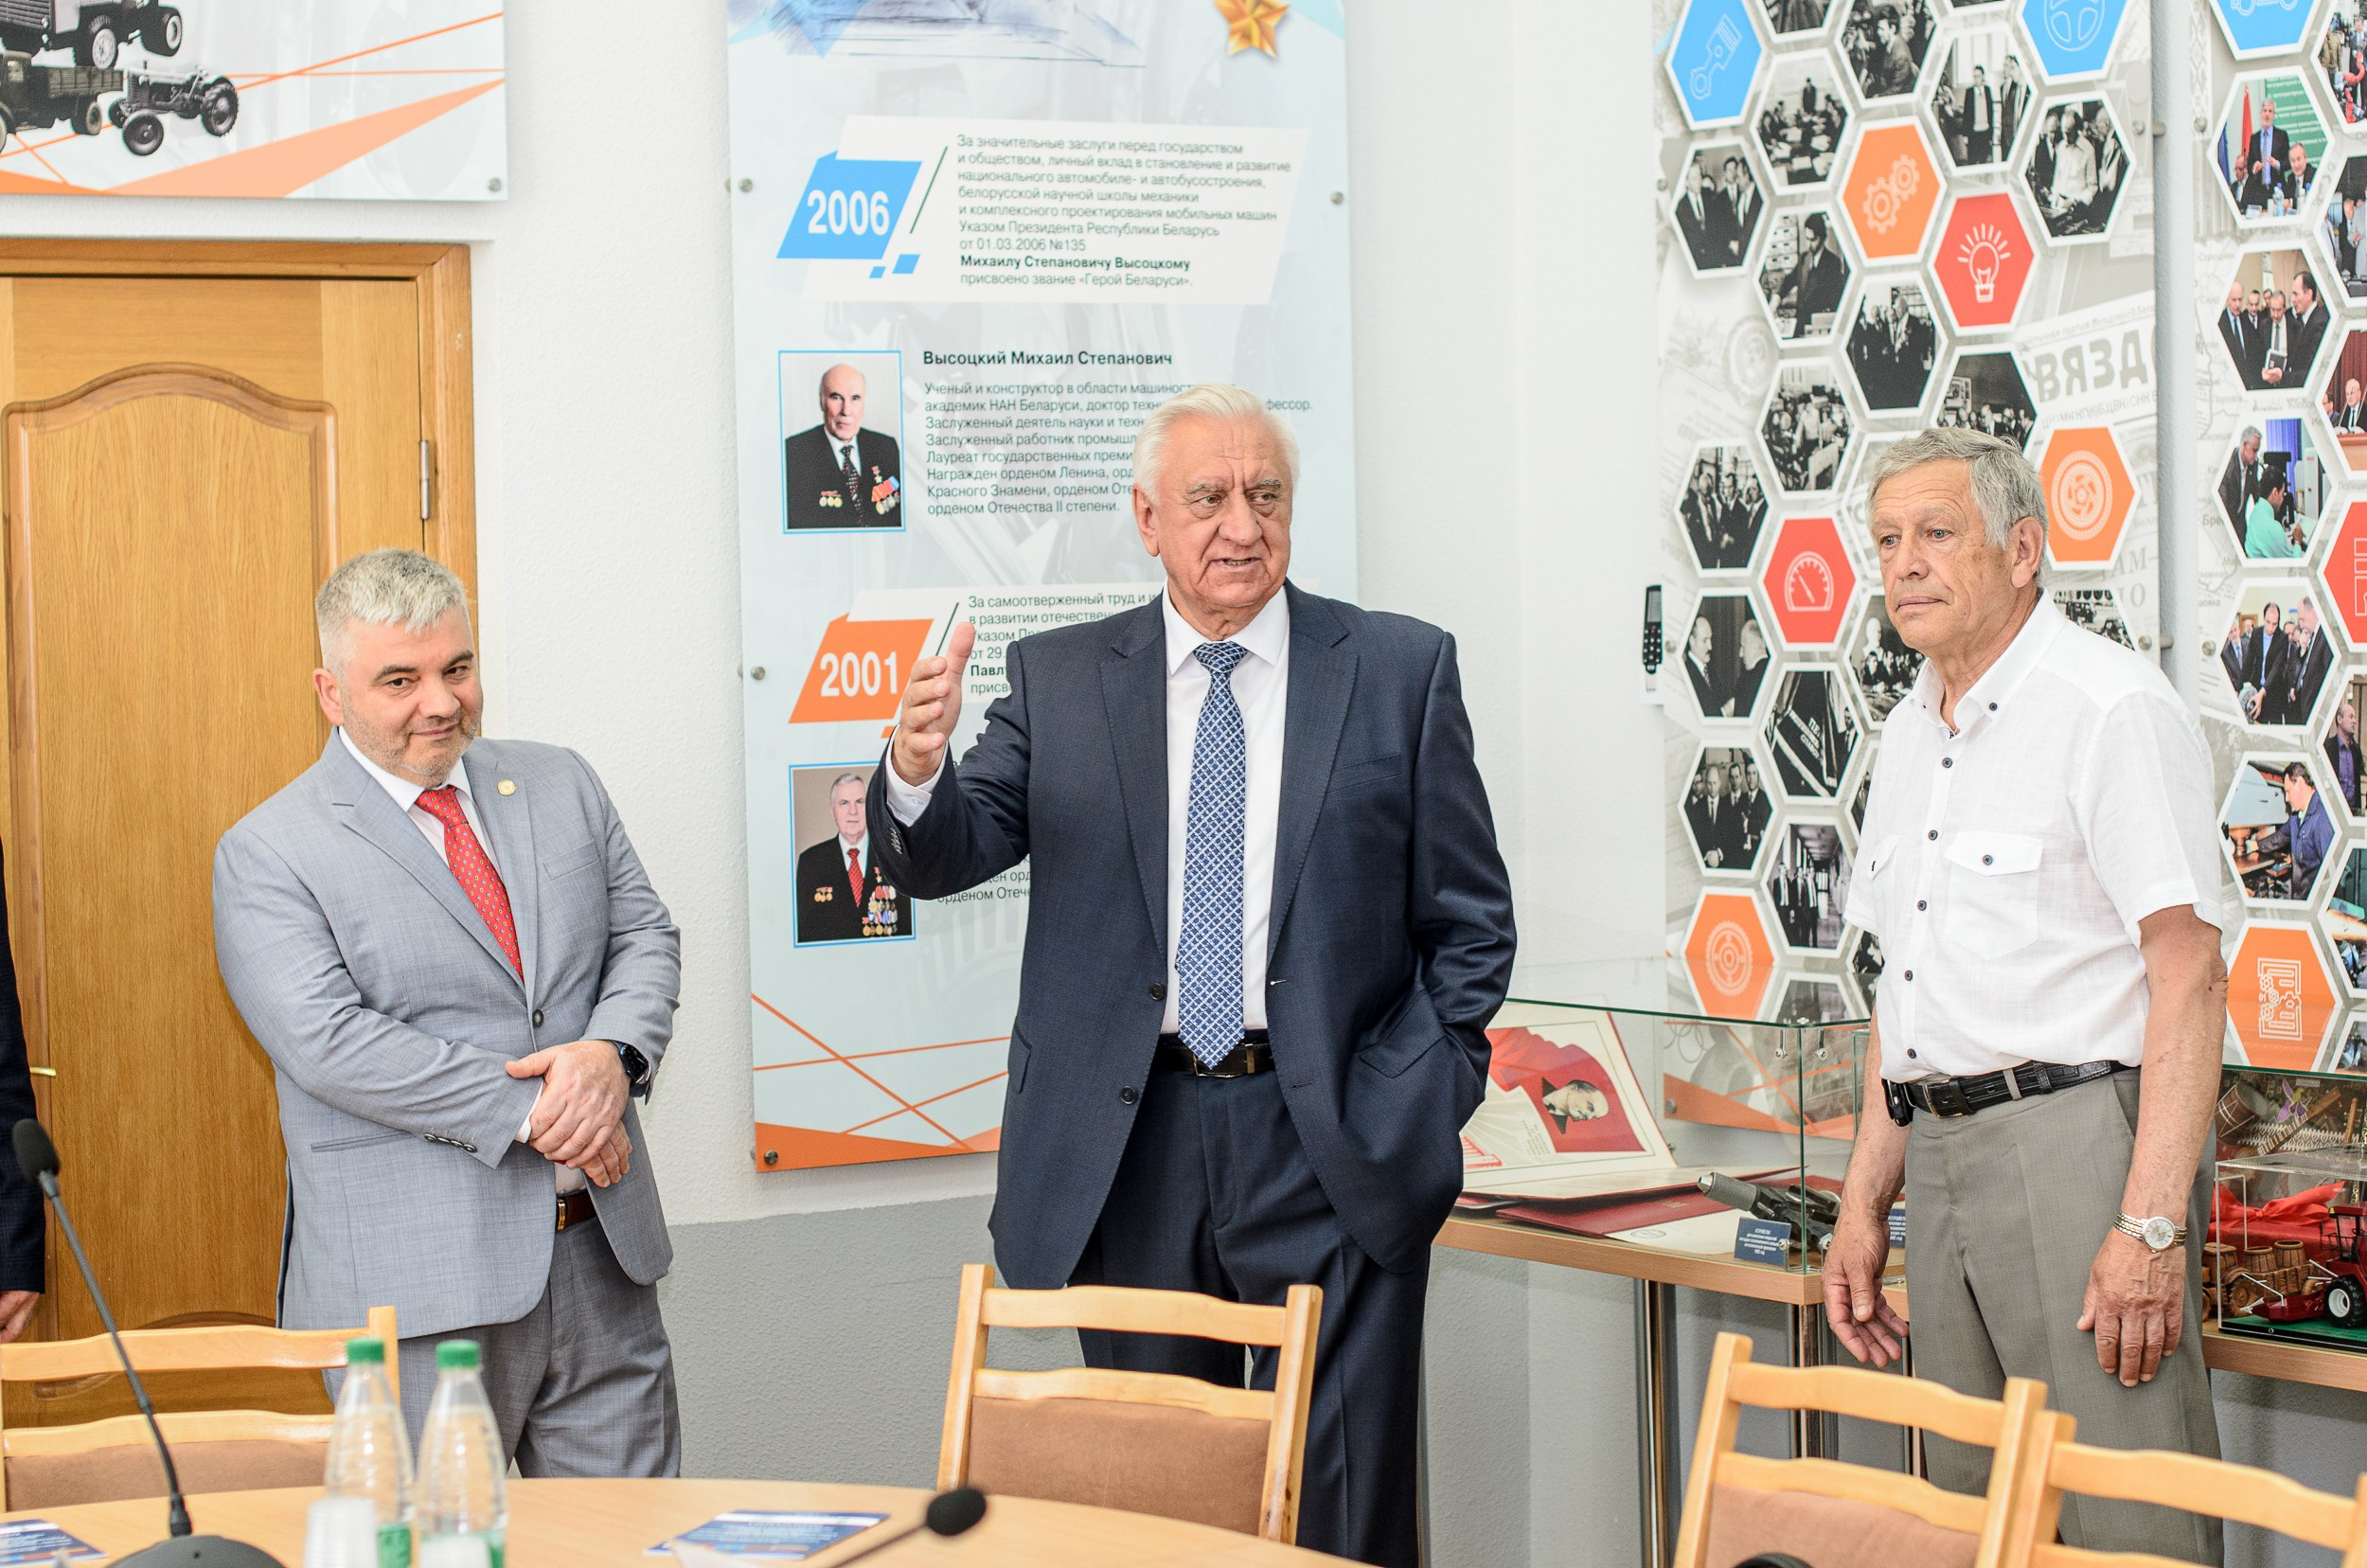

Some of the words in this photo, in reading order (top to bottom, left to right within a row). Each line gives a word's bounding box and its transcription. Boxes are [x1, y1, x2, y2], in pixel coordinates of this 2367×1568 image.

[957, 134, 973, 147] За
[977, 137, 1065, 149] значительные
[1068, 138, 1116, 152] заслуги
[1119, 140, 1156, 153] перед
[1159, 141, 1243, 155] государством
[958, 154, 966, 164] и
[969, 151, 1044, 167] обществом,
[1048, 153, 1094, 167] личный
[1097, 157, 1134, 169] вклад
[1136, 159, 1143, 168] в
[1146, 158, 1222, 170] становление
[1226, 161, 1233, 169] и
[1236, 161, 1291, 172] развитие
[958, 169, 1054, 184] национального
[1058, 172, 1136, 185] автомобиле-
[1140, 175, 1148, 185] и
[1151, 173, 1266, 188] автобусостроения,
[958, 186, 1041, 201] белорусской
[1043, 187, 1094, 202] научной
[1097, 190, 1137, 201] школы
[1141, 192, 1199, 203] механики
[806, 189, 890, 236] 2006
[958, 205, 967, 215] и
[970, 205, 1059, 217] комплексного
[1061, 206, 1163, 220] проектирования
[1166, 207, 1233, 220] мобильных
[1237, 210, 1277, 222] машин
[959, 220, 1005, 233] Указом
[1008, 221, 1083, 236] Президента
[1087, 222, 1159, 238] Республики
[1163, 223, 1219, 239] Беларусь
[960, 240, 973, 250] от
[976, 238, 1046, 251] 01.03.2006
[960, 255, 1021, 270] Михаилу
[1024, 255, 1112, 271] Степановичу
[1115, 258, 1191, 272] Высоцкому
[960, 274, 1029, 286] присвоено
[1032, 274, 1076, 285] звание
[923, 350, 1006, 366] Высоцкий
[1010, 351, 1074, 365] Михаил
[1077, 351, 1173, 365] Степанович
[2022, 328, 2157, 403] ВЯЗД
[924, 382, 972, 395] Ученый
[975, 384, 983, 394] и
[987, 383, 1063, 397] конструктор
[1067, 384, 1074, 394] в
[1077, 382, 1127, 394] области
[925, 401, 986, 412] академик
[989, 399, 1016, 411] НАН
[1021, 399, 1083, 414] Беларуси,
[1086, 401, 1130, 414] доктор
[1266, 399, 1313, 413] фессор.
[926, 417, 1012, 431] Заслуженный
[1016, 418, 1066, 430] деятель
[1069, 418, 1104, 431] науки
[1108, 418, 1114, 427] и
[1118, 418, 1145, 427] техн
[926, 433, 1013, 448] Заслуженный
[1016, 433, 1075, 448] работник
[1077, 435, 1137, 447] промышл
[926, 451, 978, 465] Лауреат
[983, 452, 1091, 465] государственных
[1094, 452, 1133, 464] преми
[927, 468, 997, 482] Награжден
[1001, 469, 1056, 481] орденом
[1059, 467, 1109, 480] Ленина,
[927, 485, 988, 498] Красного
[991, 484, 1050, 498] Знамени,
[1054, 485, 1109, 497] орденом
[928, 502, 984, 517] орденом
[988, 501, 1053, 513] Отечества
[1066, 501, 1120, 514] степени.
[969, 596, 985, 608] За
[988, 593, 1104, 608] самоотверженный
[1108, 594, 1135, 606] труд
[1138, 595, 1146, 603] и
[979, 614, 1038, 626] развитии
[977, 632, 1015, 642] казом
[970, 650, 983, 660] от
[820, 651, 898, 698] 2001
[970, 666, 1006, 676] Павл
[971, 683, 1012, 696] присв
